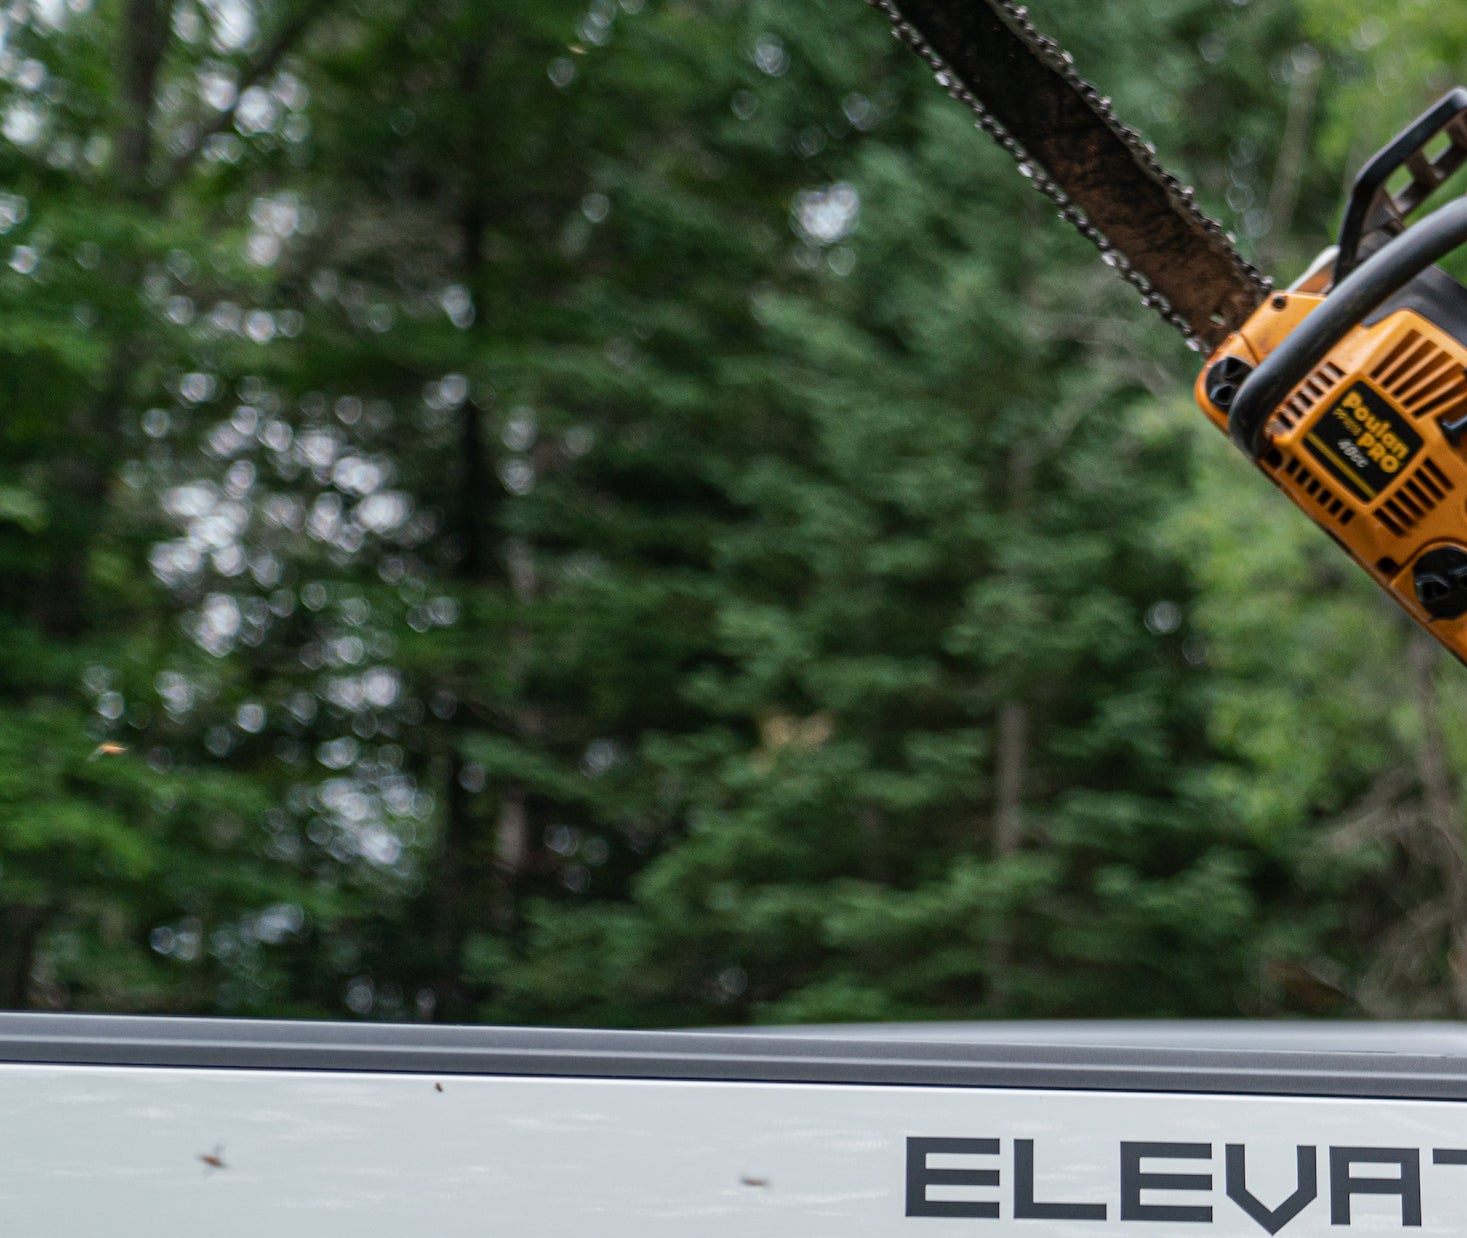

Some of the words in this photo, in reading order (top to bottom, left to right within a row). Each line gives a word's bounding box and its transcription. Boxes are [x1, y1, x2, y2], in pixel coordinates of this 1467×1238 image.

[1341, 390, 1409, 460] Poulan
[1336, 438, 1370, 468] 40cc
[1356, 431, 1400, 473] PRO
